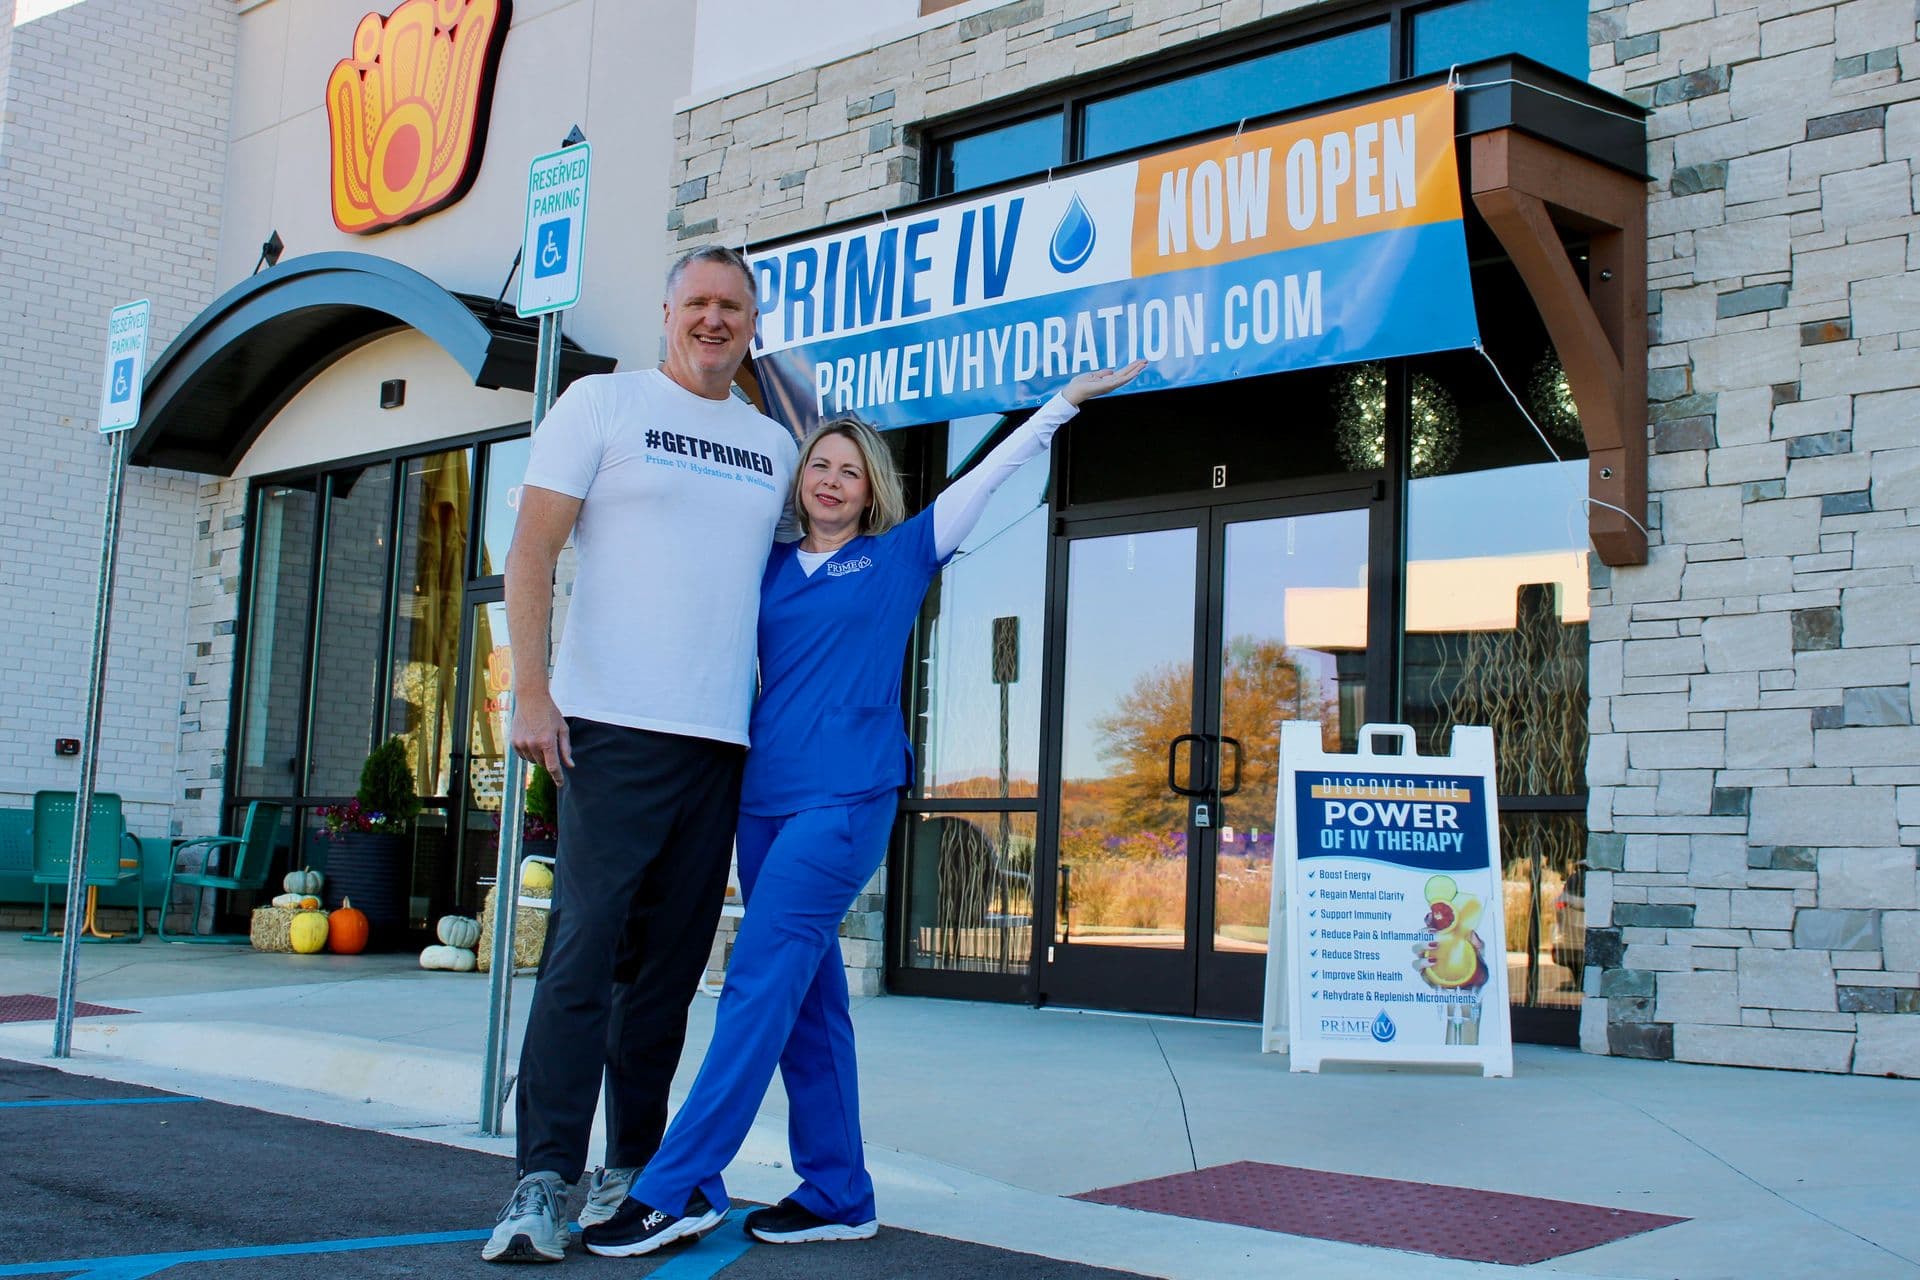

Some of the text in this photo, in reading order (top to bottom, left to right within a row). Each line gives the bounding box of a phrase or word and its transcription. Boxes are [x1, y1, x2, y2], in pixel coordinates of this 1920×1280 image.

[532, 159, 586, 193] RESERVED
[1157, 113, 1417, 257] NOW OPEN
[533, 187, 580, 218] PARKING
[751, 197, 1025, 352] PRIME IV
[111, 312, 146, 336] RESERVED
[111, 334, 141, 354] PARKING
[815, 270, 1323, 417] PRIMEIVHYDRATION.COM
[644, 429, 774, 477] #GETPRIMED
[645, 454, 674, 468] Prime
[690, 463, 733, 481] Hydration
[1215, 468, 1224, 486] B
[827, 561, 858, 573] PRIME
[1322, 777, 1460, 799] DISCOVER THE
[1324, 801, 1459, 829] POWER
[1320, 829, 1465, 853] OF IV THERAPY
[1319, 870, 1371, 881] Boost Energy
[1320, 889, 1405, 902] Regain Mental Clarity
[1320, 909, 1392, 921] Support Immunity
[1321, 929, 1434, 942] Reduce Pain & Inflammation
[1321, 949, 1380, 961] Reduce Stress
[1322, 971, 1403, 982] Improve Skin Health
[1322, 989, 1477, 1005] Rehydrate & Replenish Micronutrients
[1321, 1019, 1391, 1035] PRIME IV
